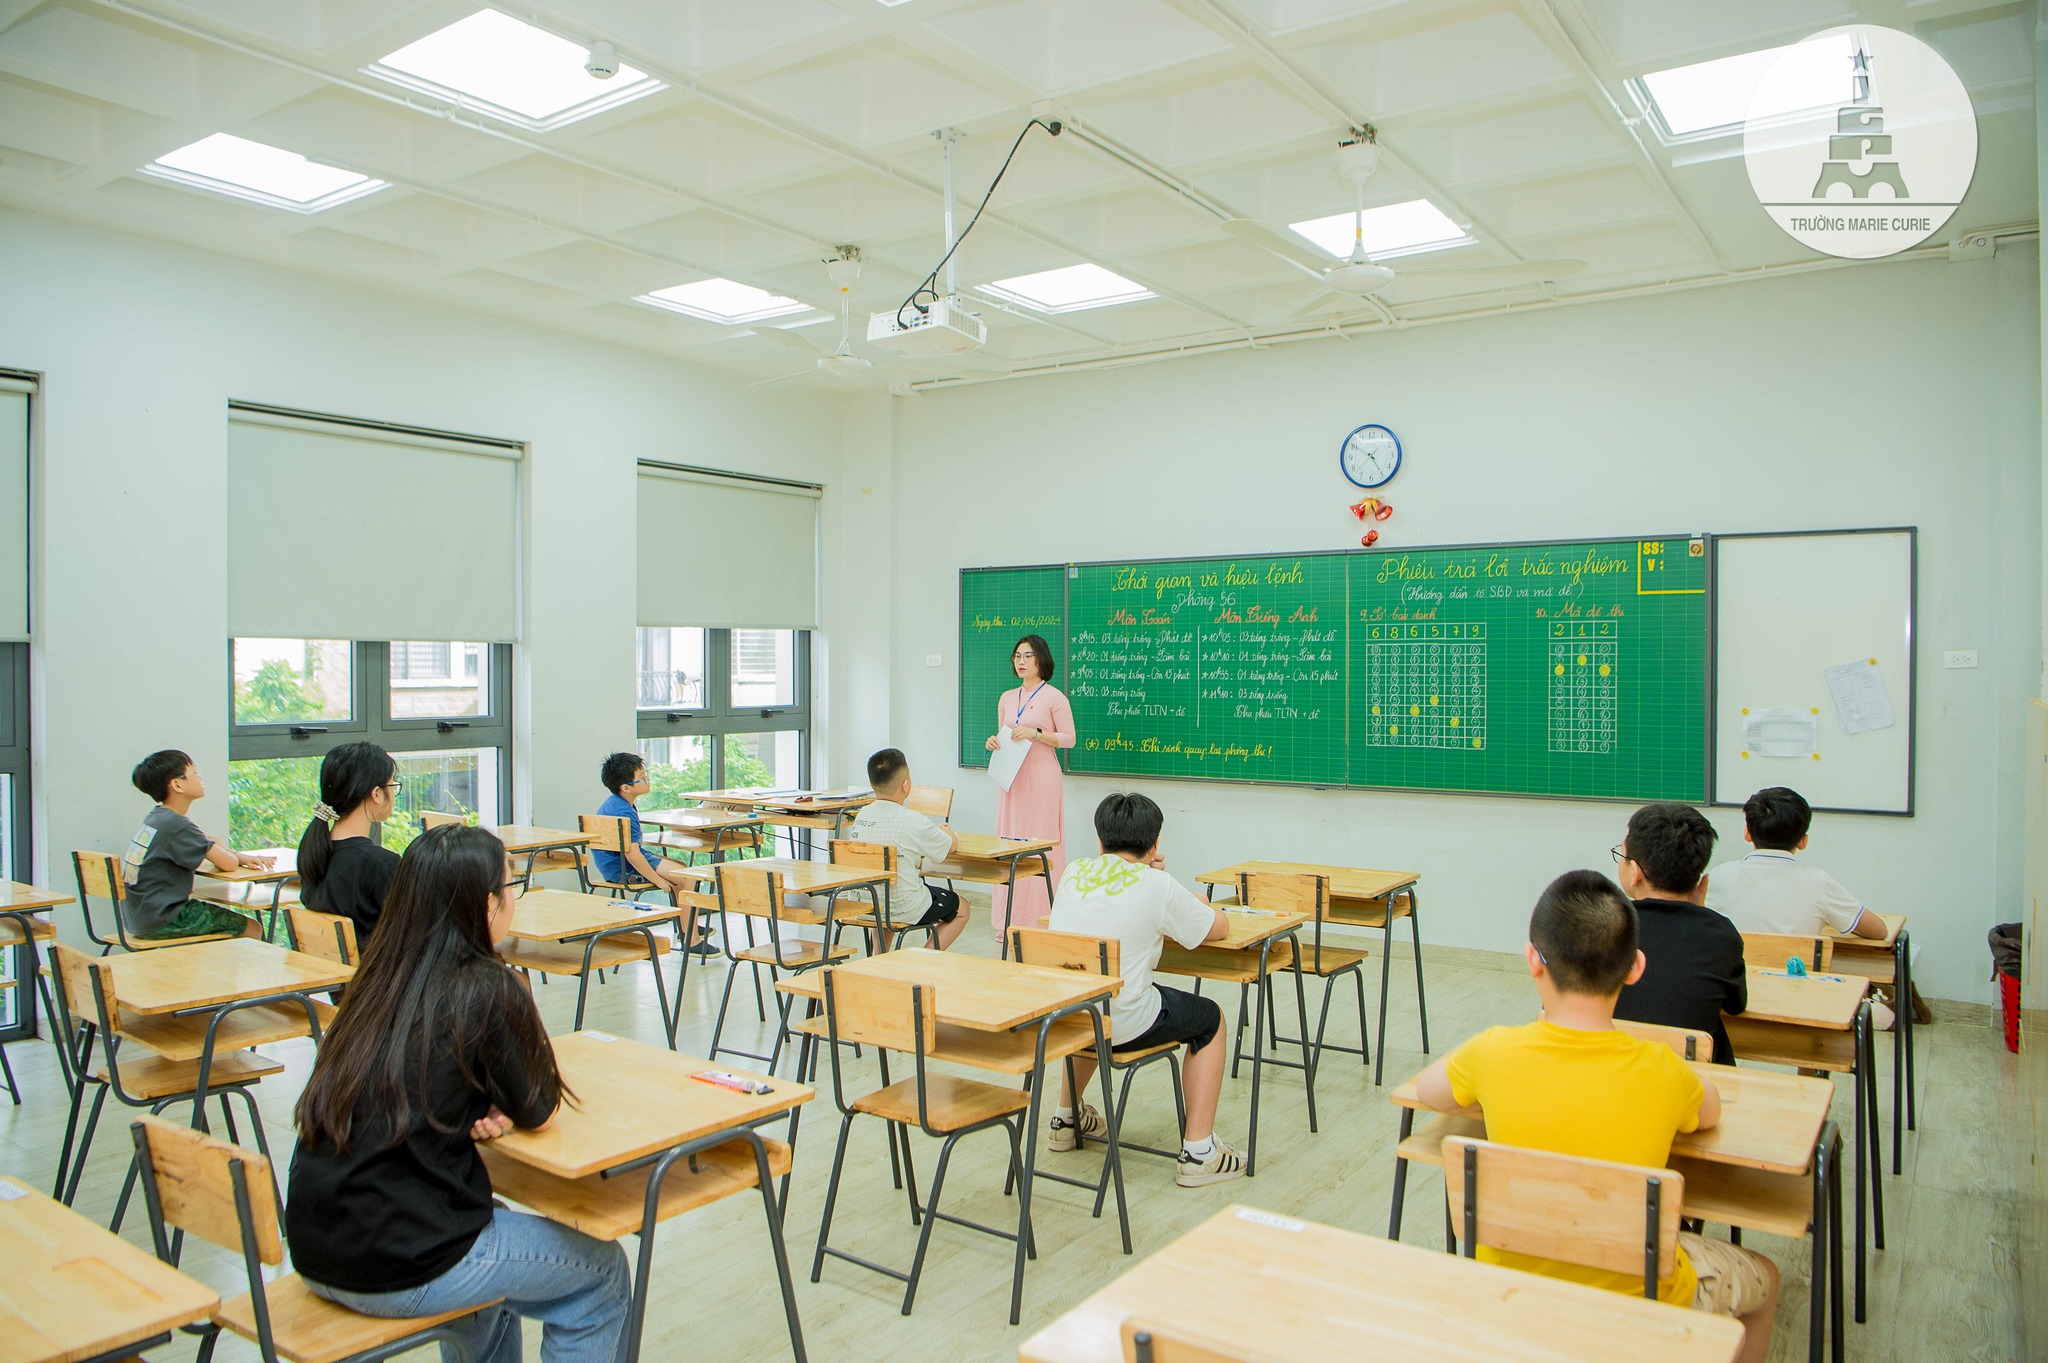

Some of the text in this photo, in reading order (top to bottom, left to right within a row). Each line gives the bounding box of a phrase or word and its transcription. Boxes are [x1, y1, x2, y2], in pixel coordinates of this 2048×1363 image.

[1642, 542, 1664, 555] SS:
[1376, 548, 1628, 585] Phiếu trả lời trắc nghiệm
[1112, 567, 1149, 592] Thời
[1155, 574, 1191, 600] gian
[1223, 563, 1259, 590] hiệu
[1264, 560, 1304, 588] lệnh
[1490, 586, 1513, 598] SBD
[1220, 591, 1236, 607] 56
[1214, 608, 1242, 624] Môn
[1288, 604, 1318, 624] Anh
[1412, 607, 1437, 620] danh
[1607, 604, 1624, 617] thi
[1011, 616, 1061, 628] 02/06/2024
[1108, 608, 1137, 626] Môn
[1240, 630, 1250, 642] 03
[1372, 625, 1479, 638] 6 8 6 5 7 9
[1554, 624, 1609, 636] 2 1 2
[1102, 632, 1112, 643] 03
[1100, 650, 1109, 662] 01
[1238, 652, 1249, 661] 01
[1100, 668, 1109, 680] 01
[1164, 669, 1172, 680] 15
[1237, 669, 1247, 680] 01
[1310, 670, 1320, 680] 15
[1101, 686, 1110, 696] 03
[1238, 688, 1248, 699] 03
[1144, 704, 1168, 716] TLTN
[1274, 707, 1298, 719] TLTN
[1162, 740, 1181, 754] sinh
[1184, 746, 1206, 761] quay
